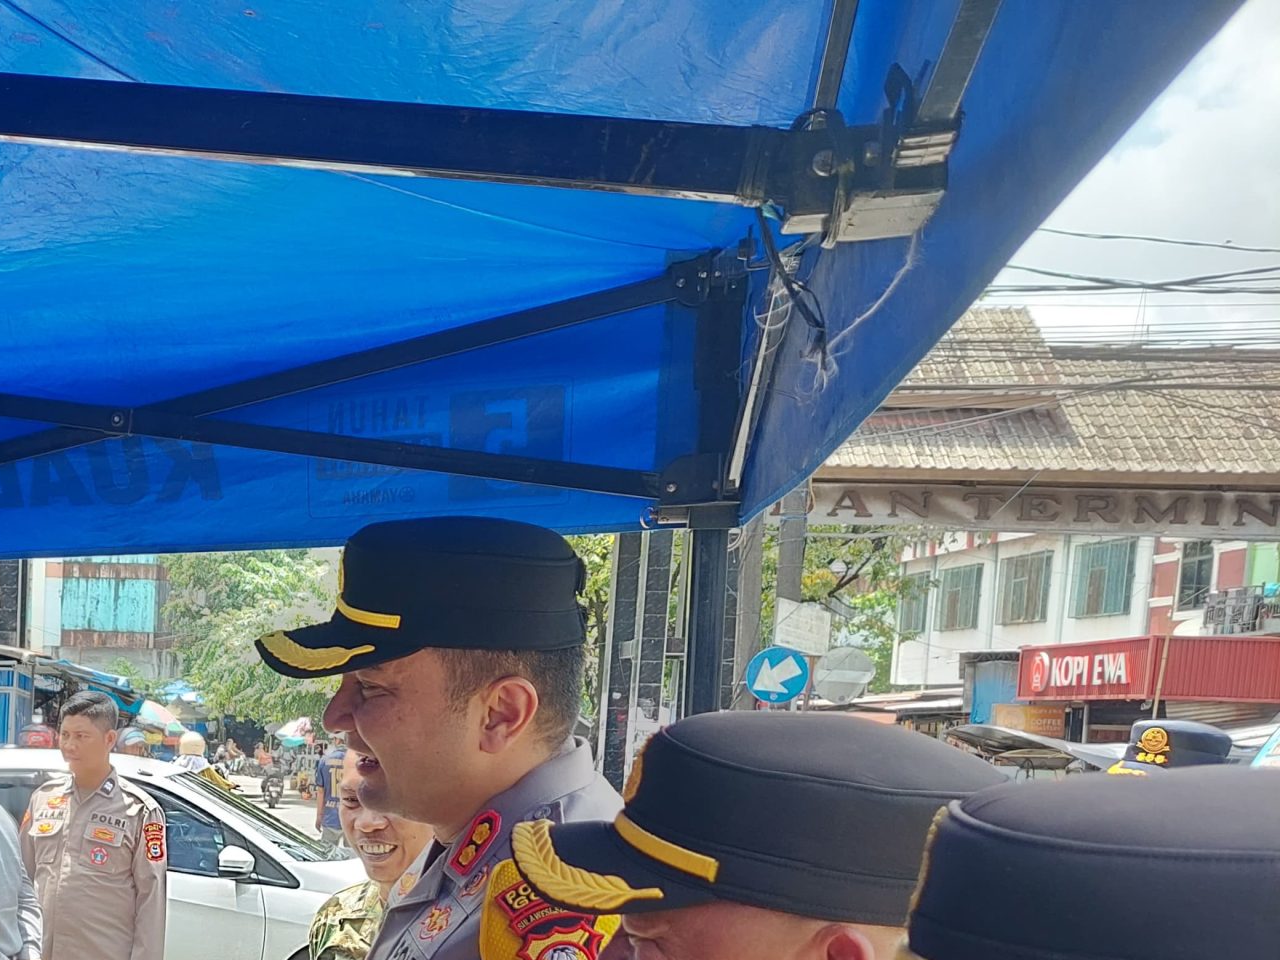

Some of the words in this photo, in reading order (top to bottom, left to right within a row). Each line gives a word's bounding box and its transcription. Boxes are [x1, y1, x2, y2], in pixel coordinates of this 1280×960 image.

[1049, 654, 1089, 688] KOPI
[1091, 651, 1129, 686] EWA
[90, 813, 127, 829] POLRI
